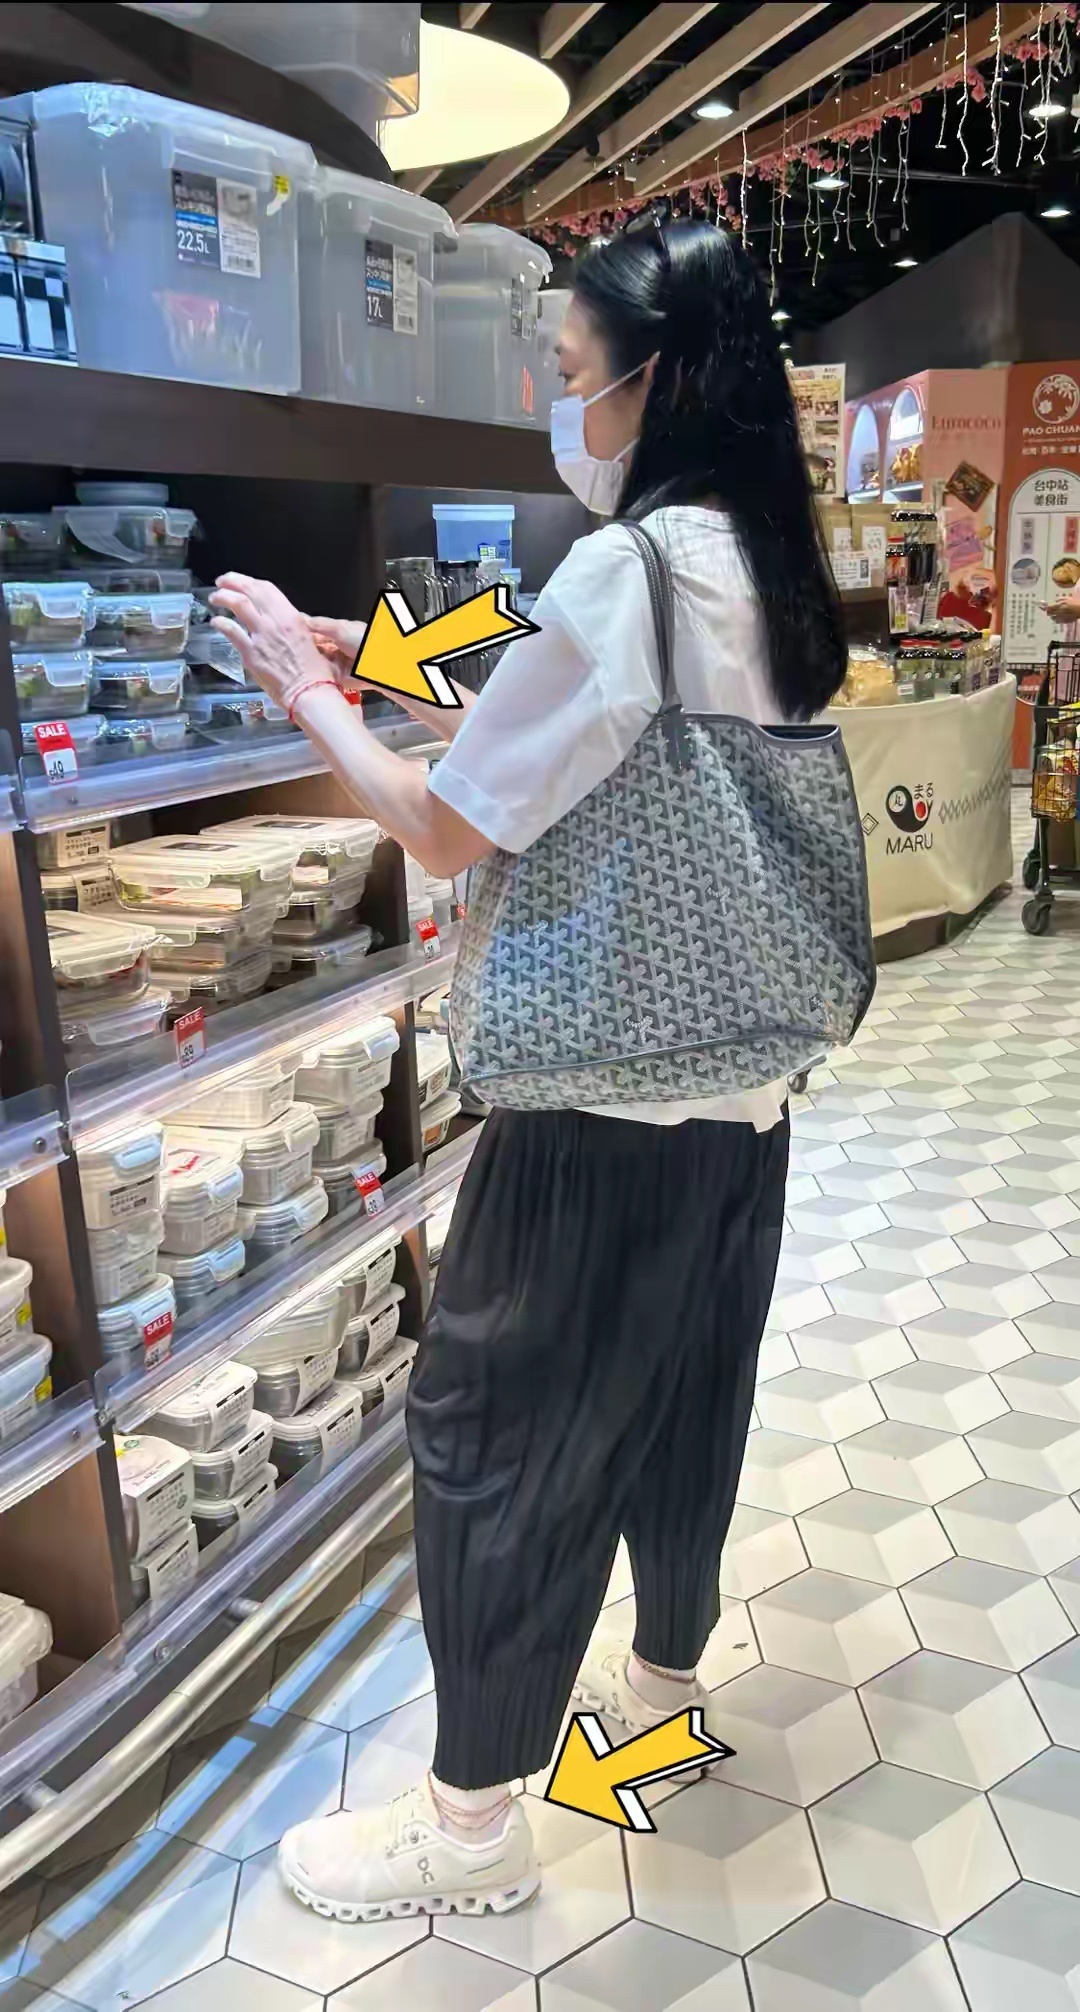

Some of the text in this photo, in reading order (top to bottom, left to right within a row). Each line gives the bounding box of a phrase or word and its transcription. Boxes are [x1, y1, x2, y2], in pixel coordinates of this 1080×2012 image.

[176, 229, 211, 254] 22.5L
[37, 723, 67, 739] SALE
[912, 782, 935, 801] まる
[885, 833, 934, 856] MARU
[418, 919, 435, 932] SALE
[178, 1010, 203, 1030] SALE
[356, 1172, 376, 1188] SALE
[146, 1312, 171, 1336] SALE
